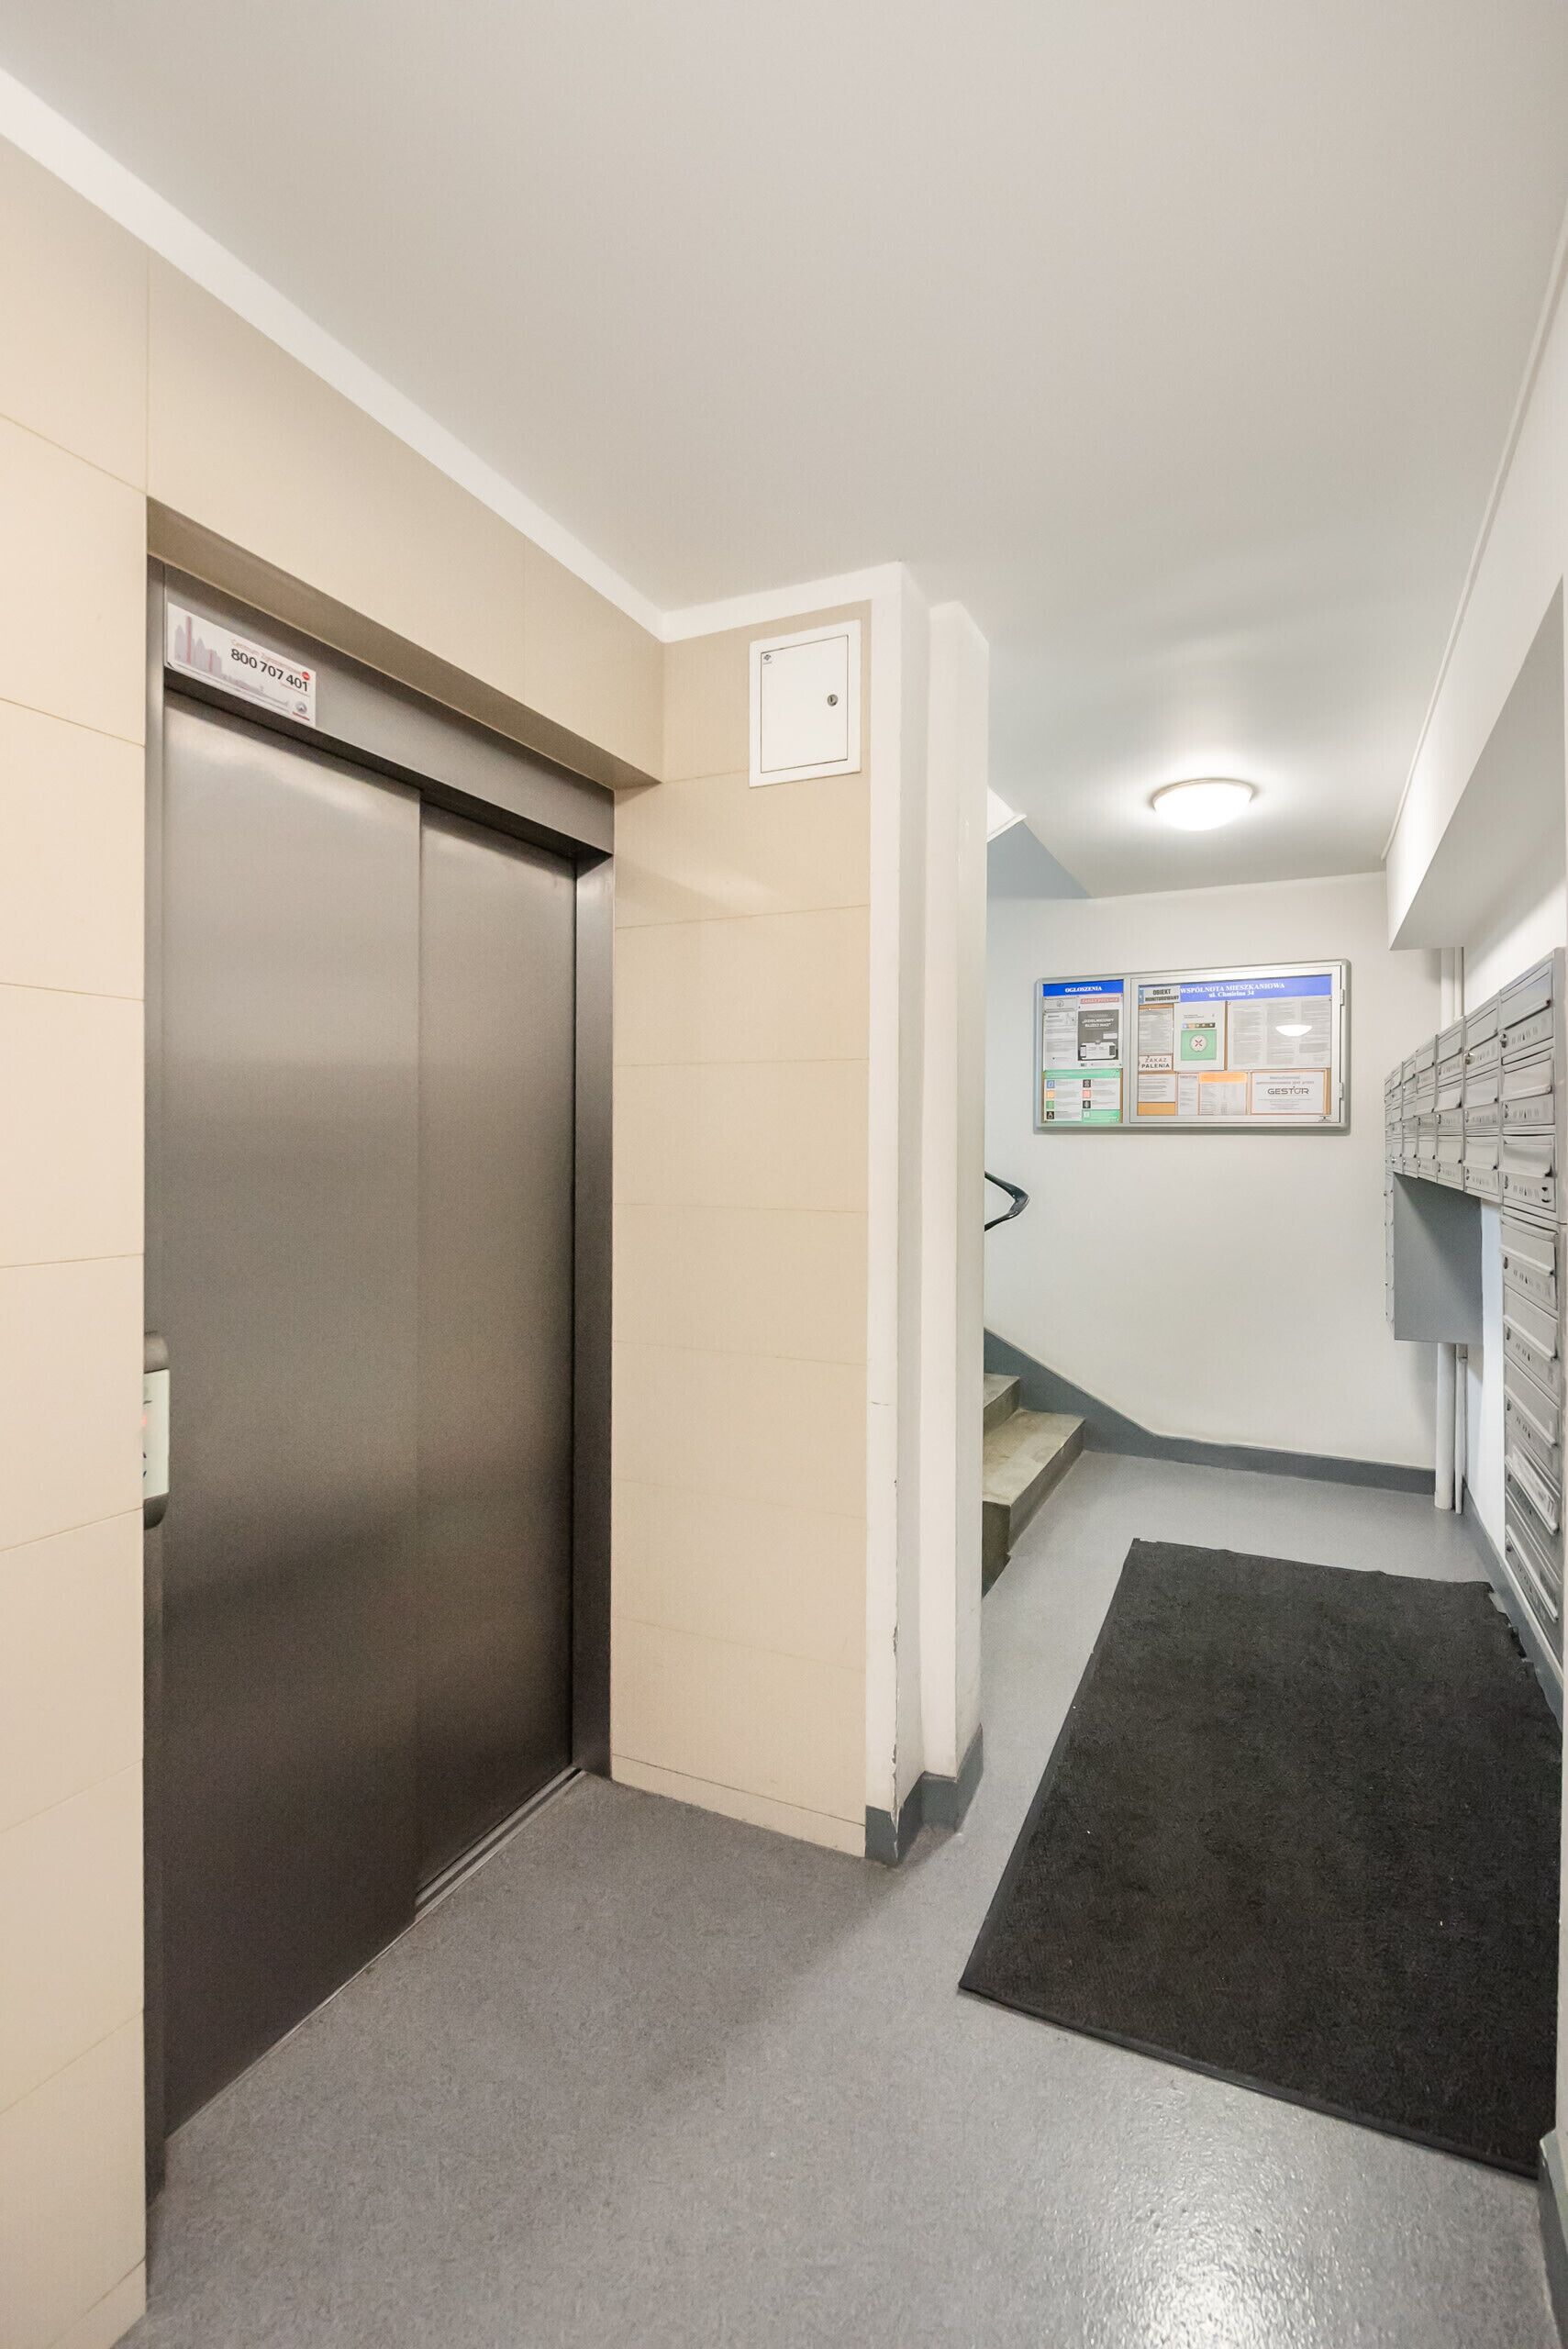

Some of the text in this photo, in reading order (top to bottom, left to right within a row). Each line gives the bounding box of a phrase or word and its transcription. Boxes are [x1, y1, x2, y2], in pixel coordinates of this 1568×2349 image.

[230, 648, 258, 669] 800
[260, 661, 284, 680] 707
[285, 674, 308, 692] 401
[1226, 983, 1285, 991] MIESZKANIOWA
